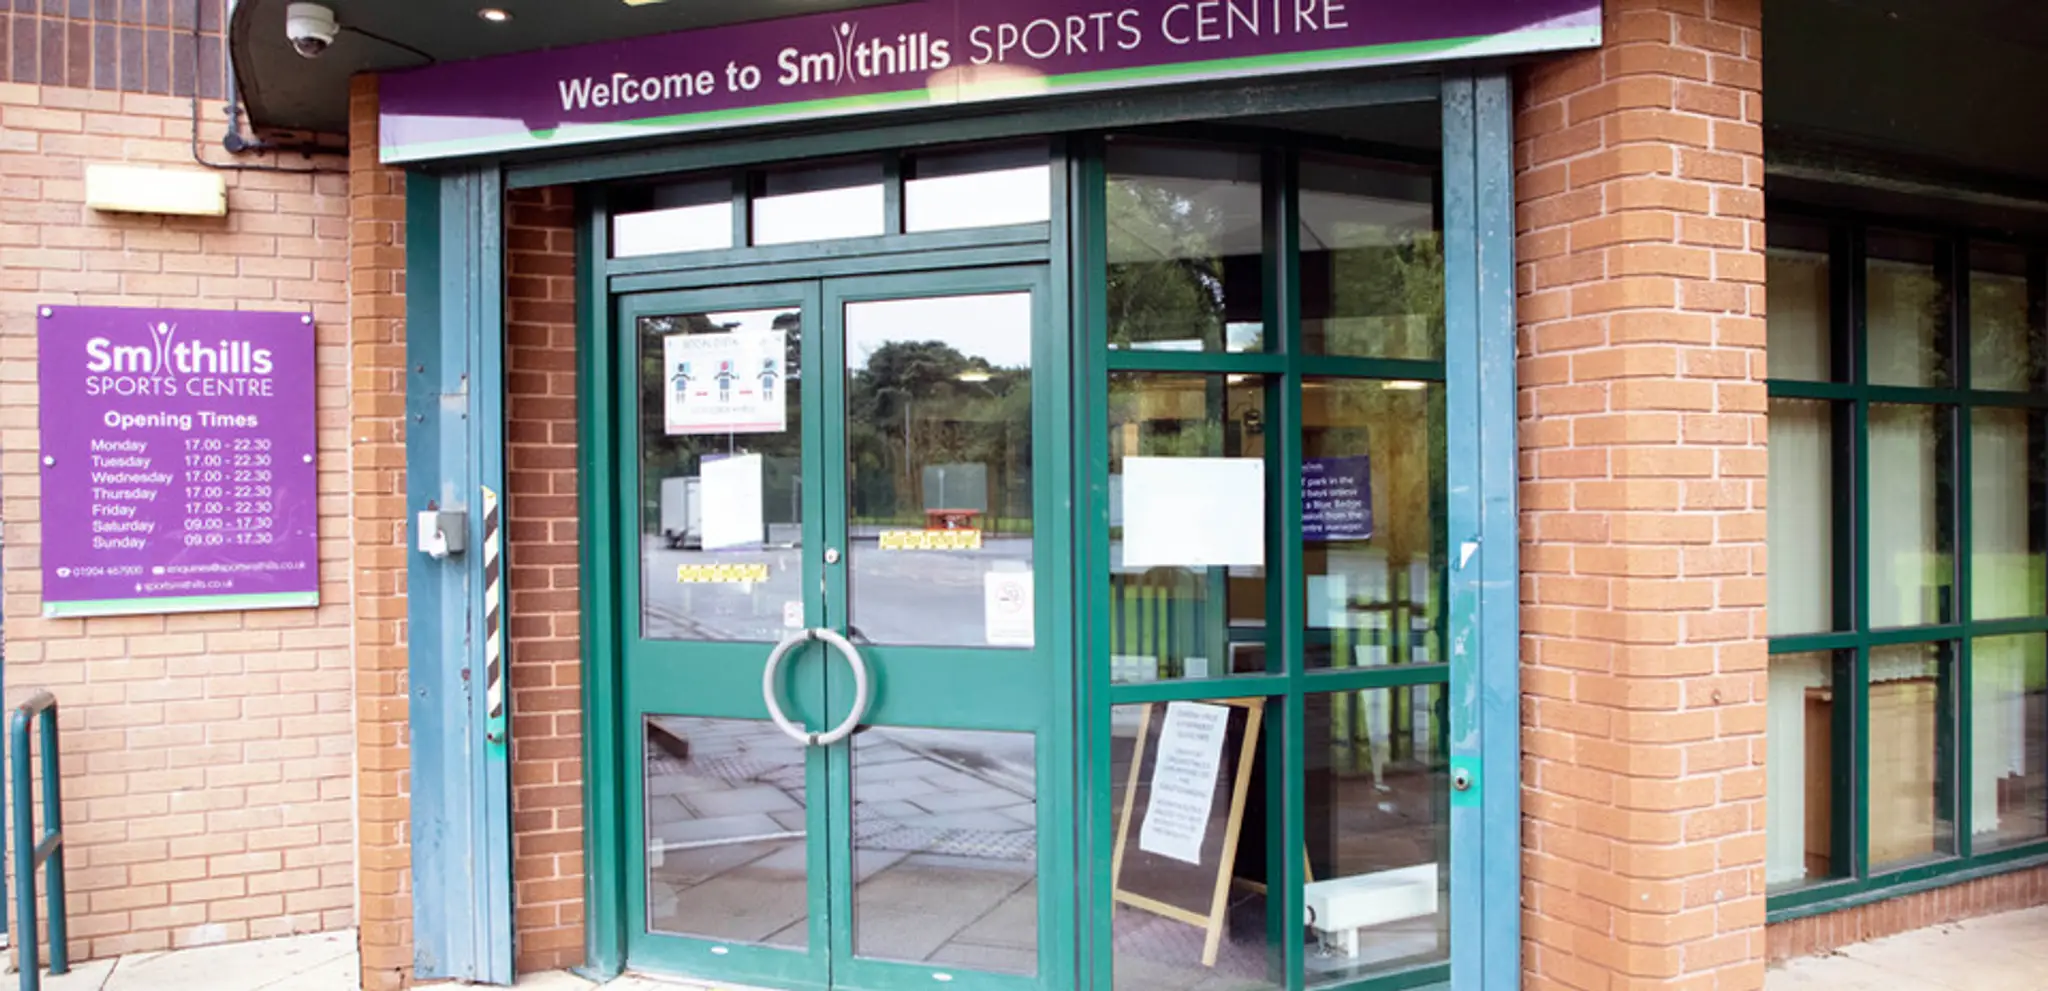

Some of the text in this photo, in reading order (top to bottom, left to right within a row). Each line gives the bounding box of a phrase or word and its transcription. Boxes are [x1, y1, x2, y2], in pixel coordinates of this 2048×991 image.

[558, 0, 1350, 111] Welcome to Smithills SPORTS CENTRE
[86, 322, 273, 376] Smithills
[85, 376, 274, 397] SPORTS CENTRE
[104, 410, 258, 430] Opening Times
[91, 439, 147, 453] Monday
[184, 438, 221, 451] 17.00
[233, 438, 272, 451] 22.30
[92, 455, 152, 469] Tuesday
[184, 454, 222, 467] 17.00
[233, 454, 272, 467] 22.30
[91, 471, 173, 485] Wednesday
[184, 470, 222, 483] 17.00
[234, 469, 272, 482] 22.30
[1339, 476, 1354, 484] the
[92, 487, 157, 501] Thursday
[185, 486, 222, 499] 17.00
[234, 485, 272, 498] 22.30
[92, 503, 137, 518] Friday
[185, 502, 222, 515] 17.00
[234, 501, 272, 514] 22.30
[92, 519, 155, 533] Saturday
[184, 518, 223, 531] 09.00
[236, 517, 272, 530] 17.30
[93, 535, 146, 550] Sunday
[184, 533, 223, 546] 09.00
[236, 532, 272, 545] 17.30
